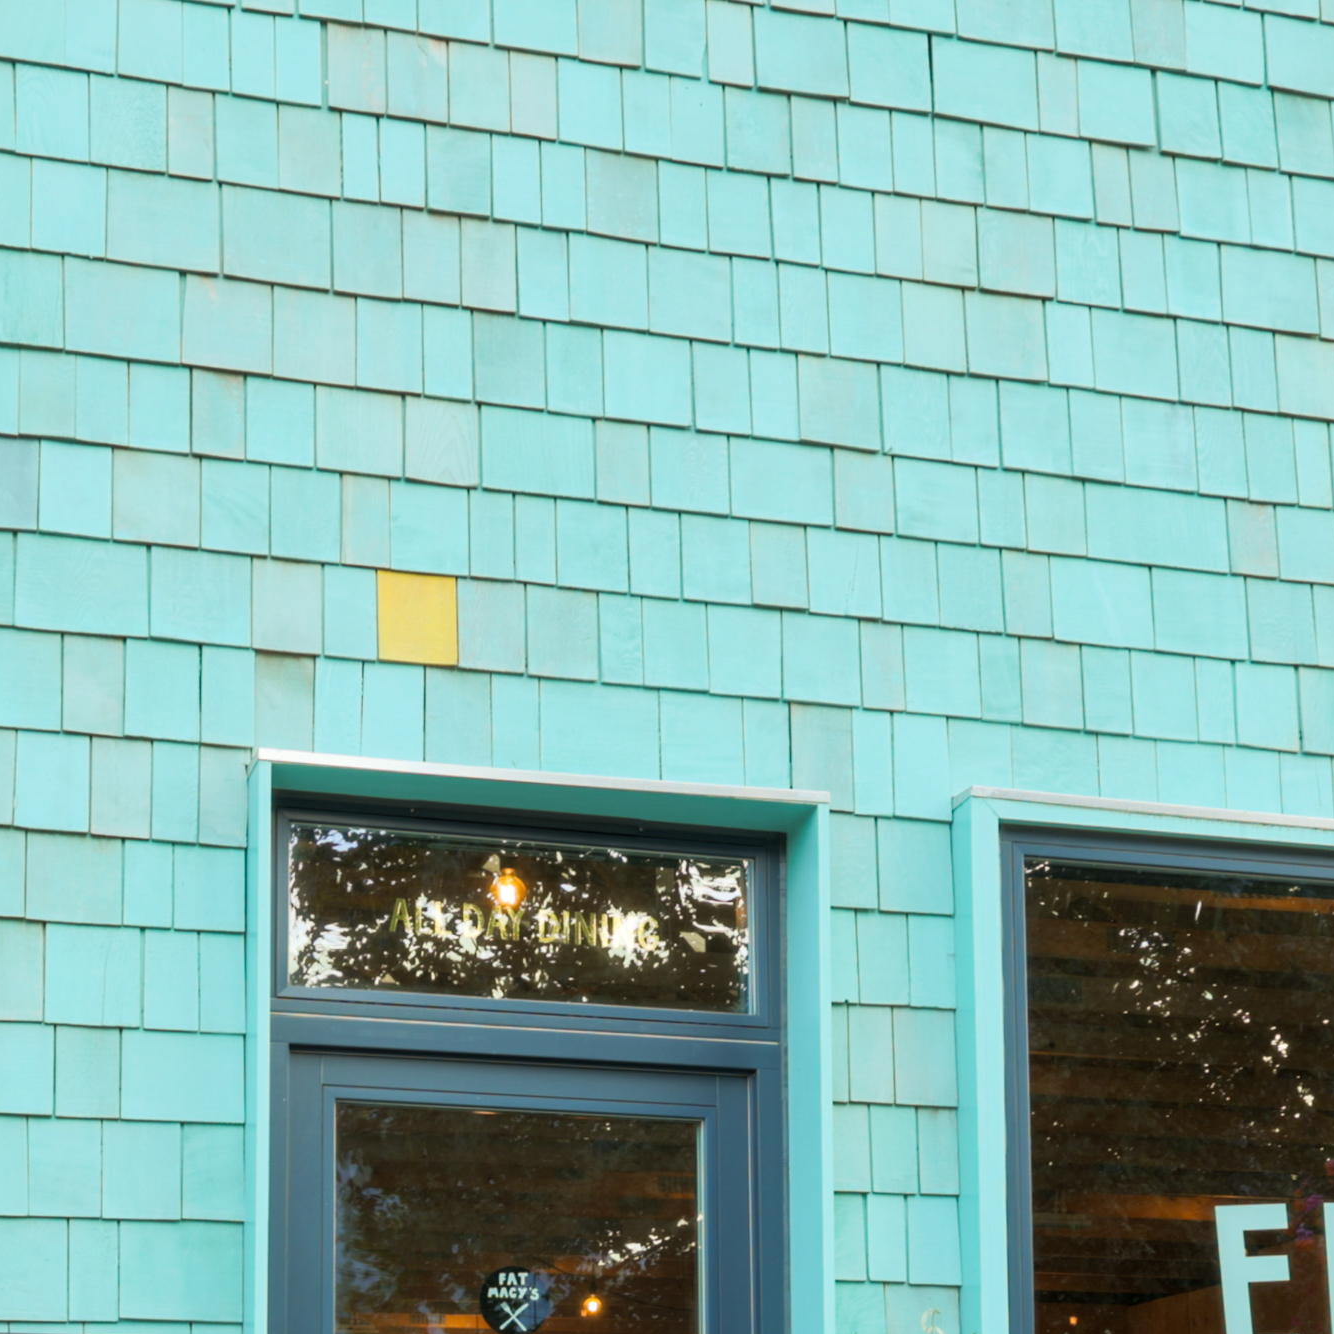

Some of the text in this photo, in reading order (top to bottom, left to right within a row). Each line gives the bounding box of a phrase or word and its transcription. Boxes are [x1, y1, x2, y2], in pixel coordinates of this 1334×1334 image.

[389, 897, 452, 936] ALL
[462, 902, 525, 941] DAY
[498, 1271, 529, 1286] FAT
[487, 1286, 540, 1301] MACY'S
